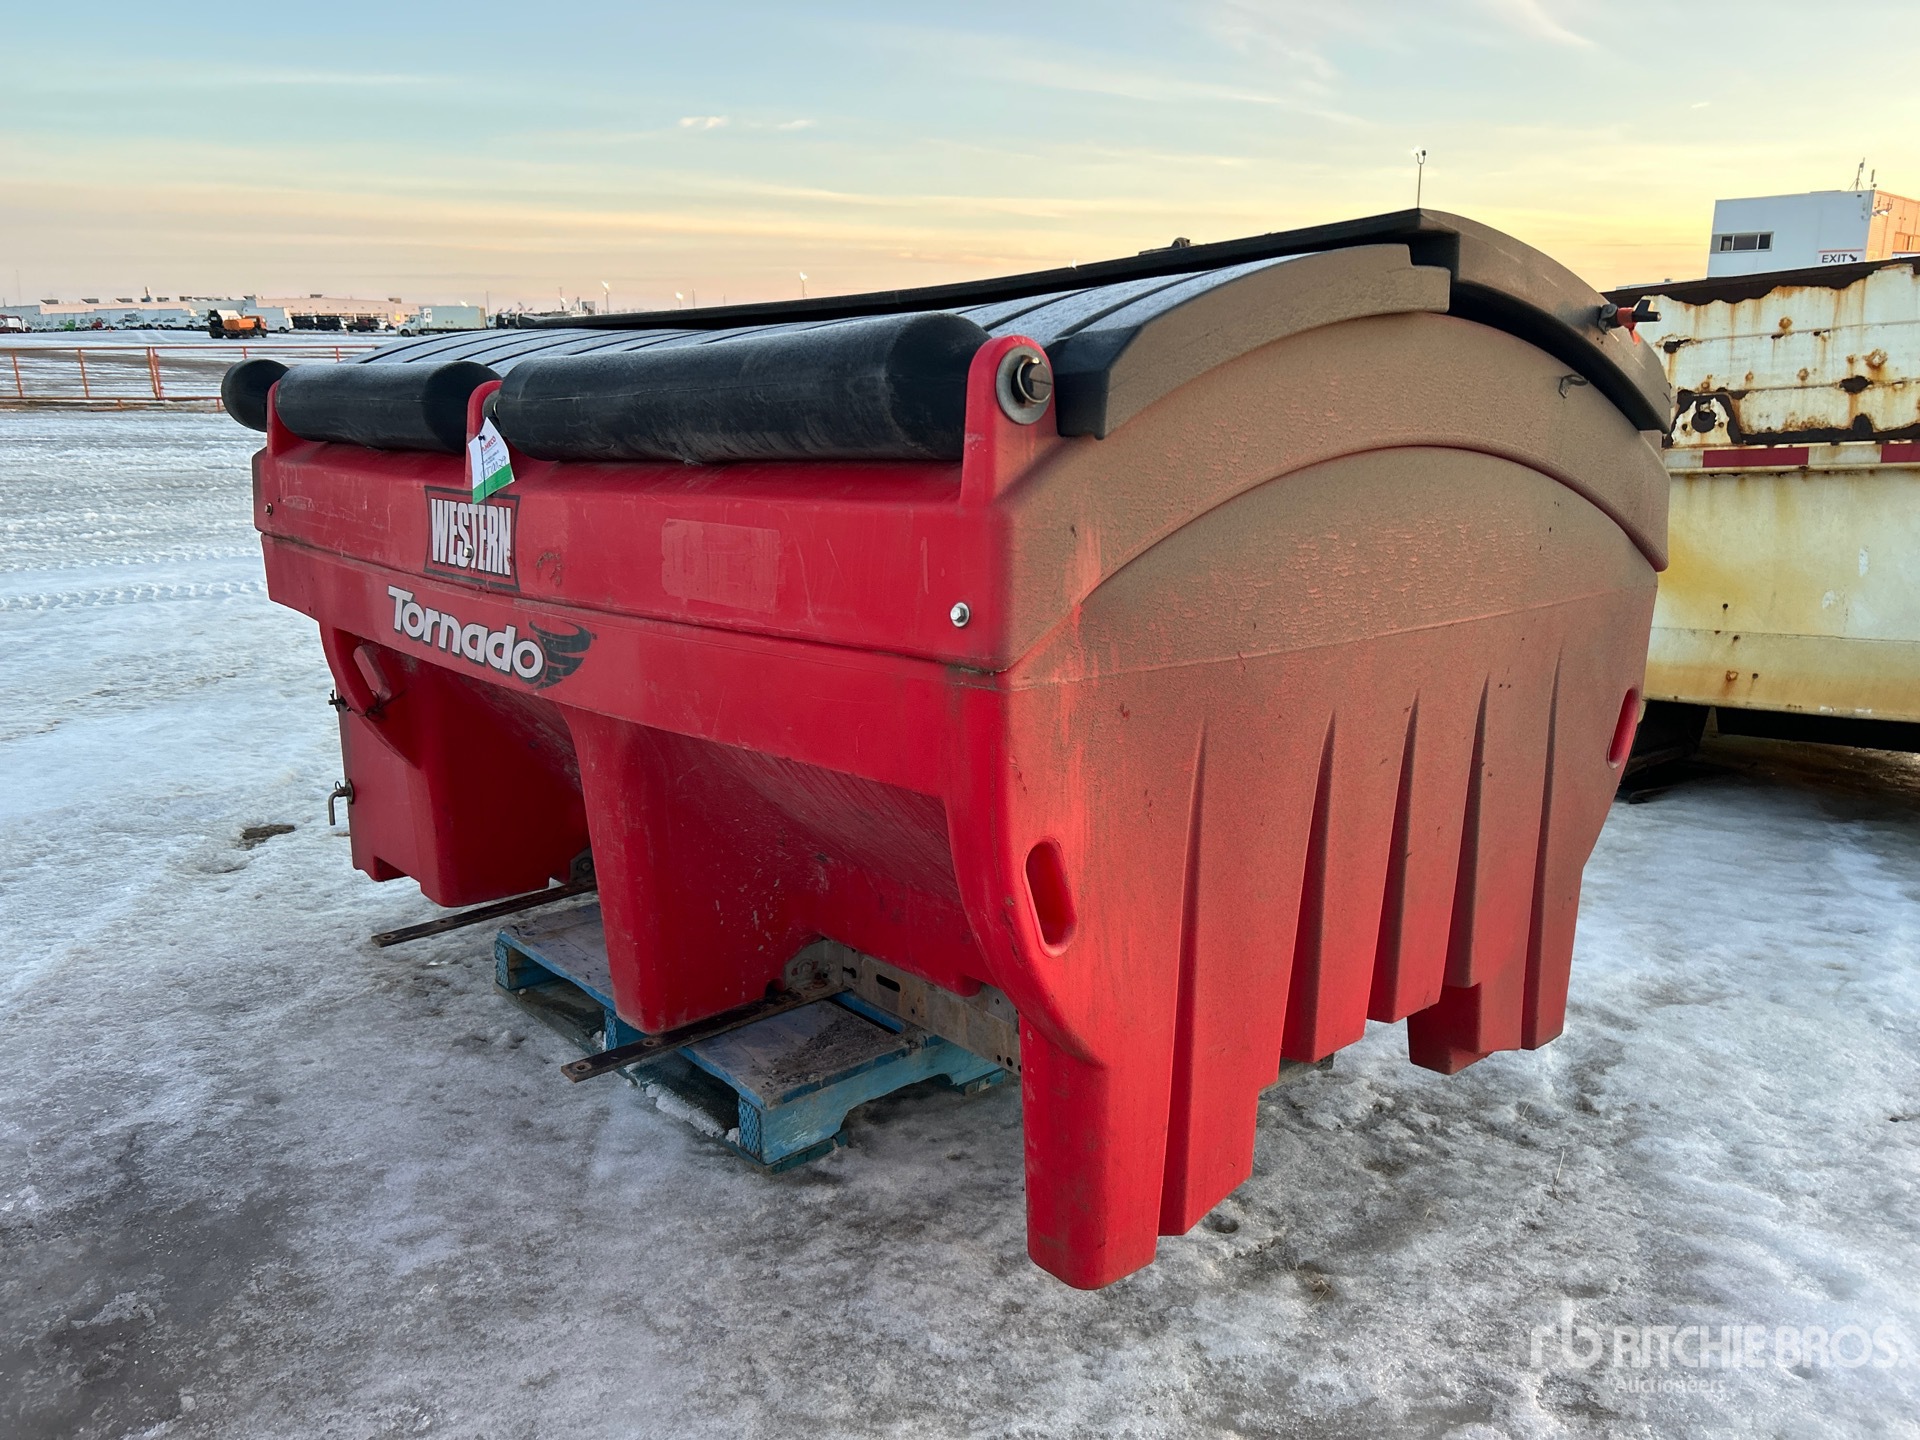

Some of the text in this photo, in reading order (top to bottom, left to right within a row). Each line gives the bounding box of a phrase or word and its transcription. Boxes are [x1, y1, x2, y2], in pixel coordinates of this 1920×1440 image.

[1821, 253, 1848, 264] EXIT
[431, 498, 512, 576] WESTERN
[387, 585, 544, 679] Tornado
